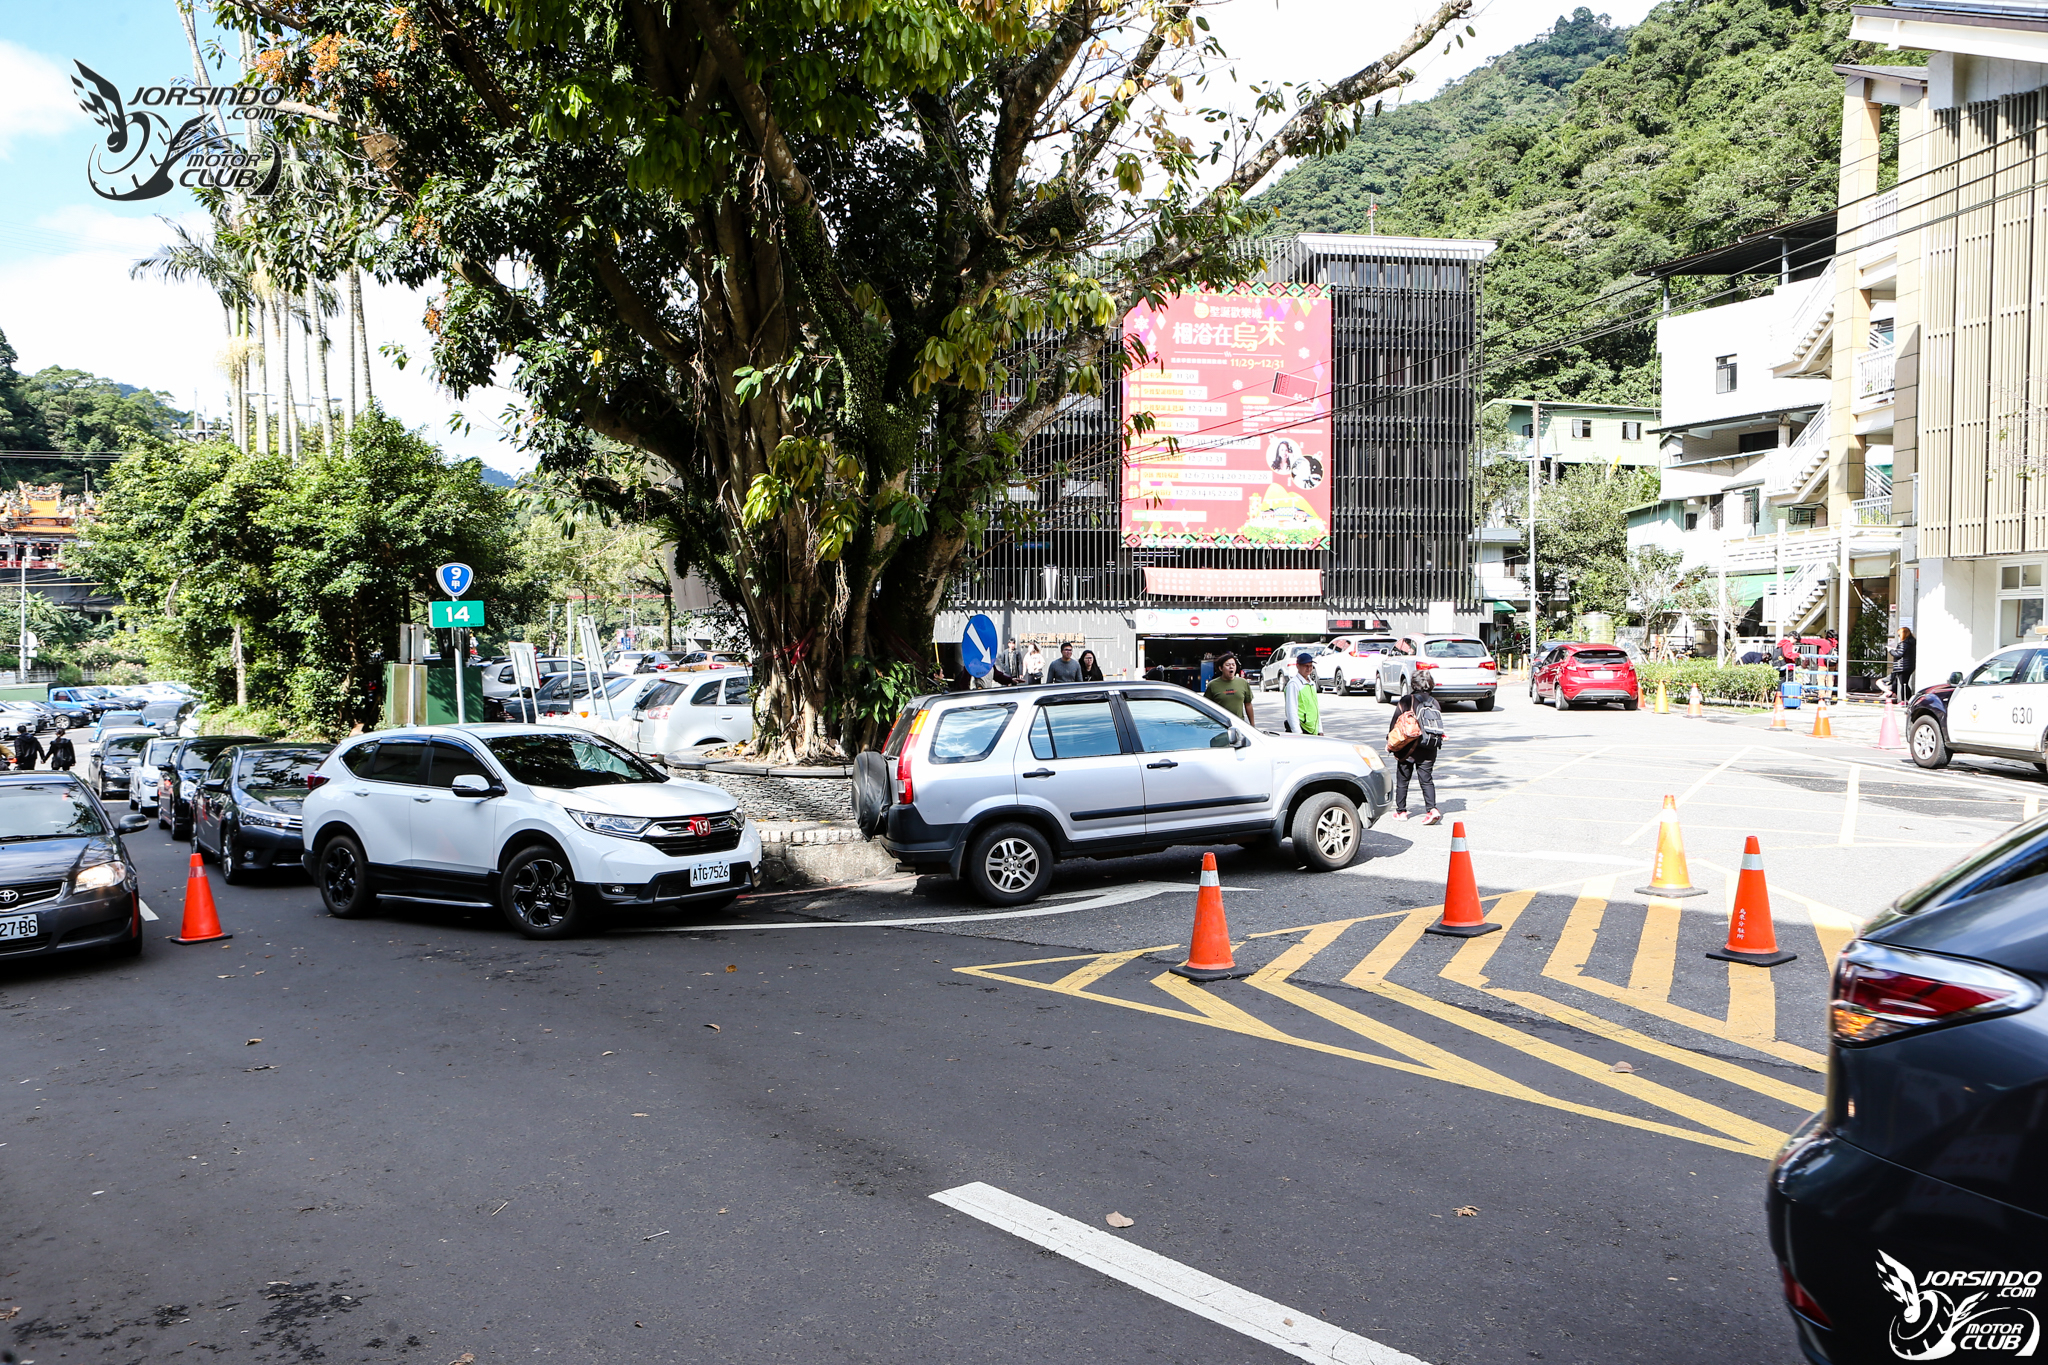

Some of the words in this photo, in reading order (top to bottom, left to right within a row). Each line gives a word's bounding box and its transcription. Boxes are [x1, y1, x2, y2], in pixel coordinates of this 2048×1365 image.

[1230, 358, 1284, 370] 11/29~12/31
[451, 567, 462, 580] 9
[451, 580, 461, 590] 甲
[445, 606, 470, 622] 14
[2011, 707, 2033, 724] 630
